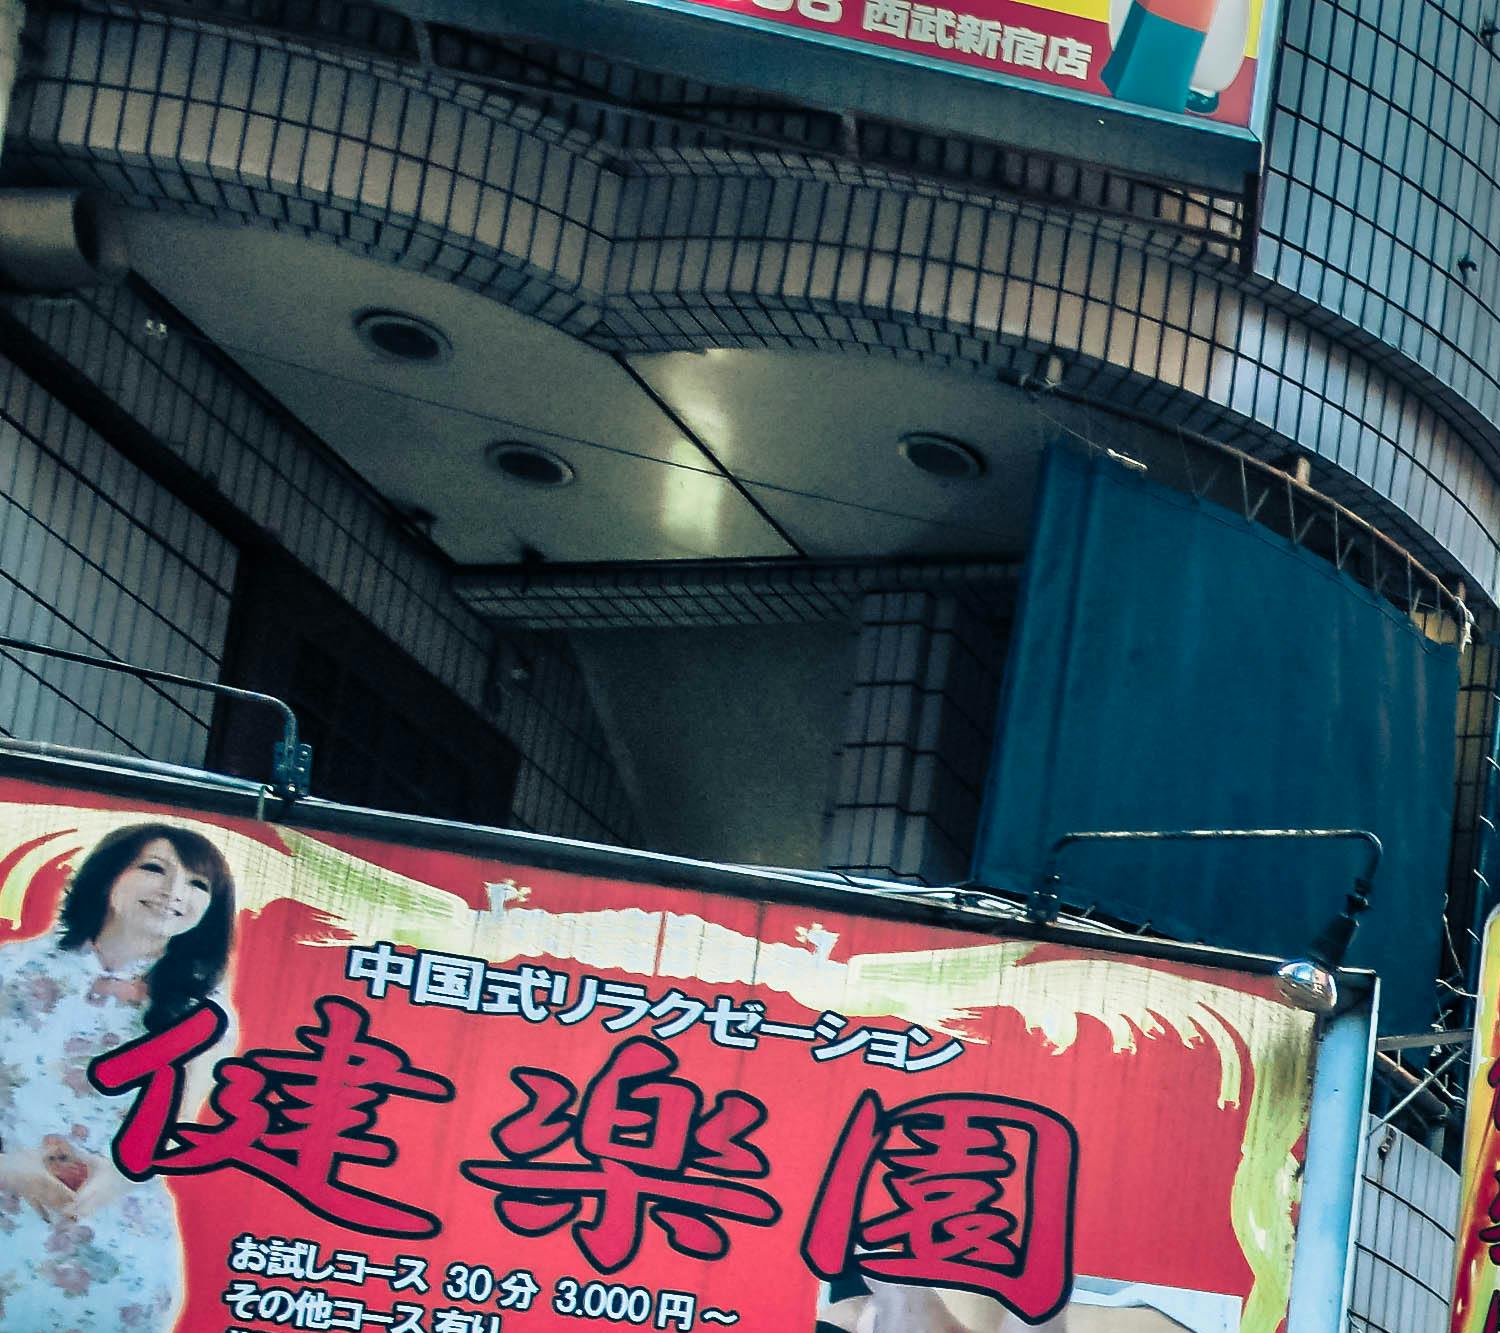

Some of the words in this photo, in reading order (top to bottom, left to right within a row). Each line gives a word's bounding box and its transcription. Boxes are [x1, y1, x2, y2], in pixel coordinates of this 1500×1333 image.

[861, 0, 1093, 80] 西武新宿店
[345, 941, 966, 1073] 中国式リラクゼーション
[85, 992, 1081, 1327] 健楽園
[227, 1235, 430, 1297] お試しコース
